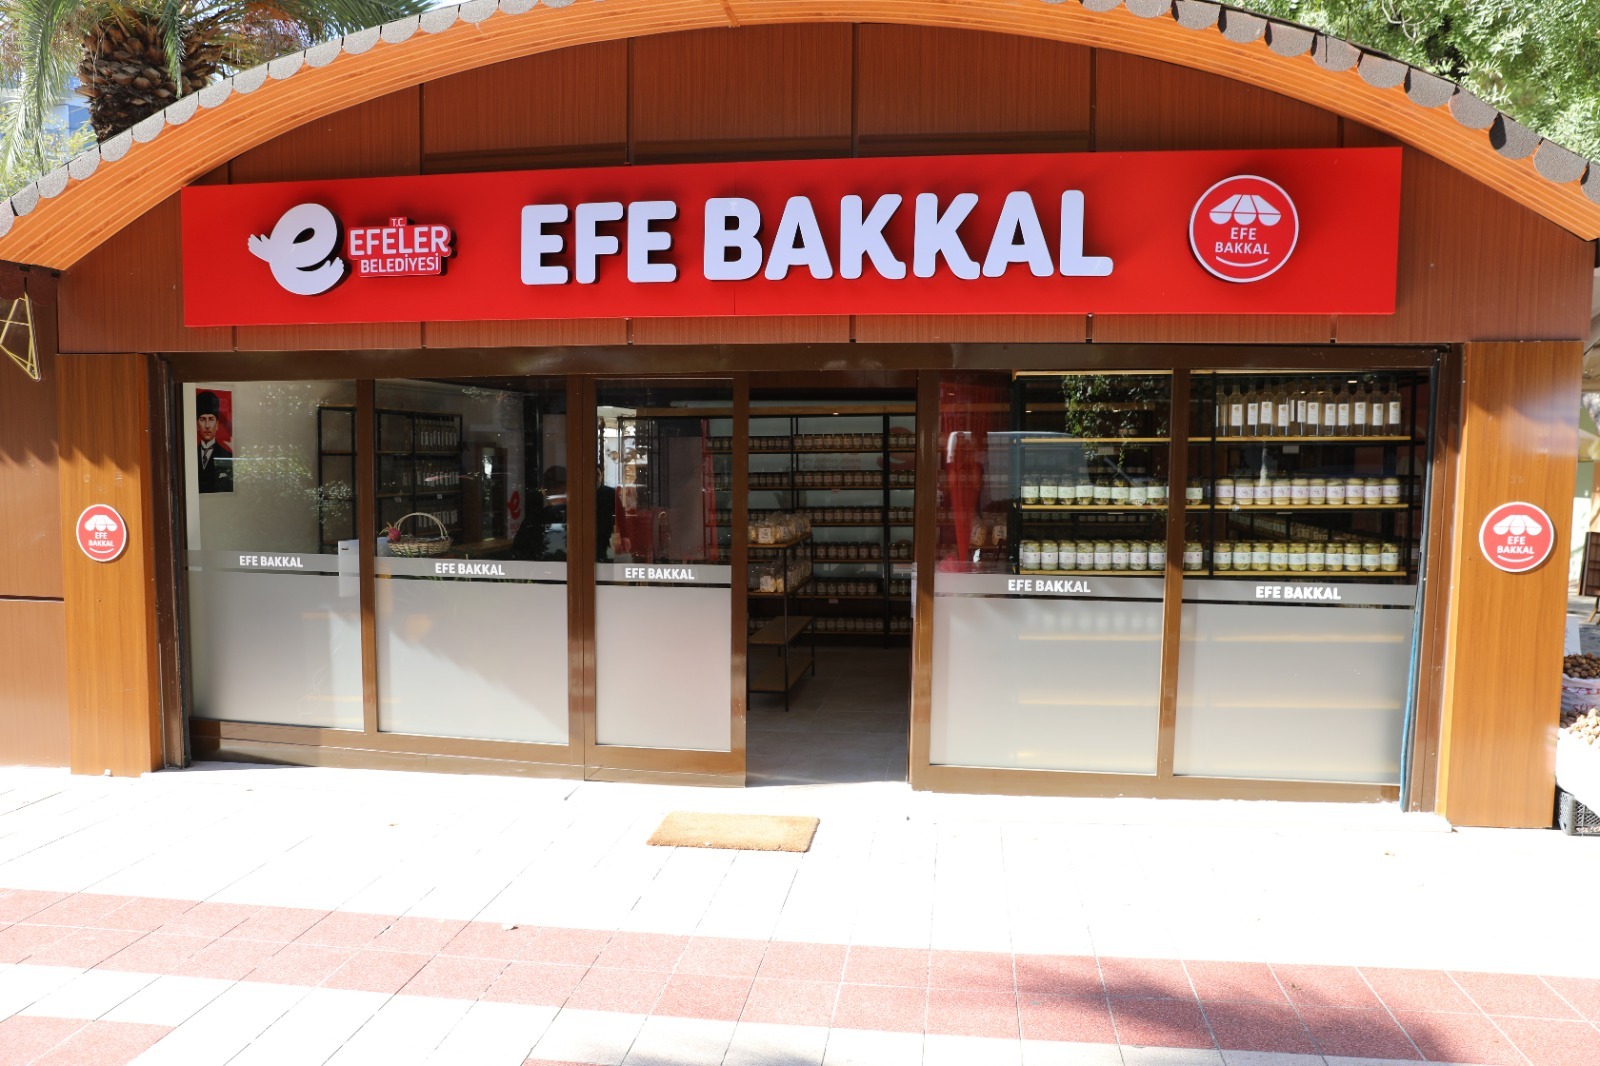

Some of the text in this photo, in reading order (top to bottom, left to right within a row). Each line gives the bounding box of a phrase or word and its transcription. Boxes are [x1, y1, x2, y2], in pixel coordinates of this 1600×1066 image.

[521, 190, 1114, 285] EFE BAKKAL
[1230, 227, 1257, 240] EFE
[350, 226, 448, 256] EFELER
[1215, 242, 1270, 255] BAKKAL
[360, 253, 439, 273] BELEDİYESİ
[94, 531, 108, 539] EFE
[1507, 535, 1526, 545] EFE
[88, 539, 114, 547] BAKKAL
[1496, 545, 1535, 554] BAKKAL
[239, 555, 304, 568] EFE BAKKAL
[435, 562, 506, 576] EFE BAKKAL
[625, 567, 695, 580] EFE BAKKAL
[1008, 579, 1091, 593] EFE BAKKAL
[1255, 585, 1342, 600] EFE BAKKAL
